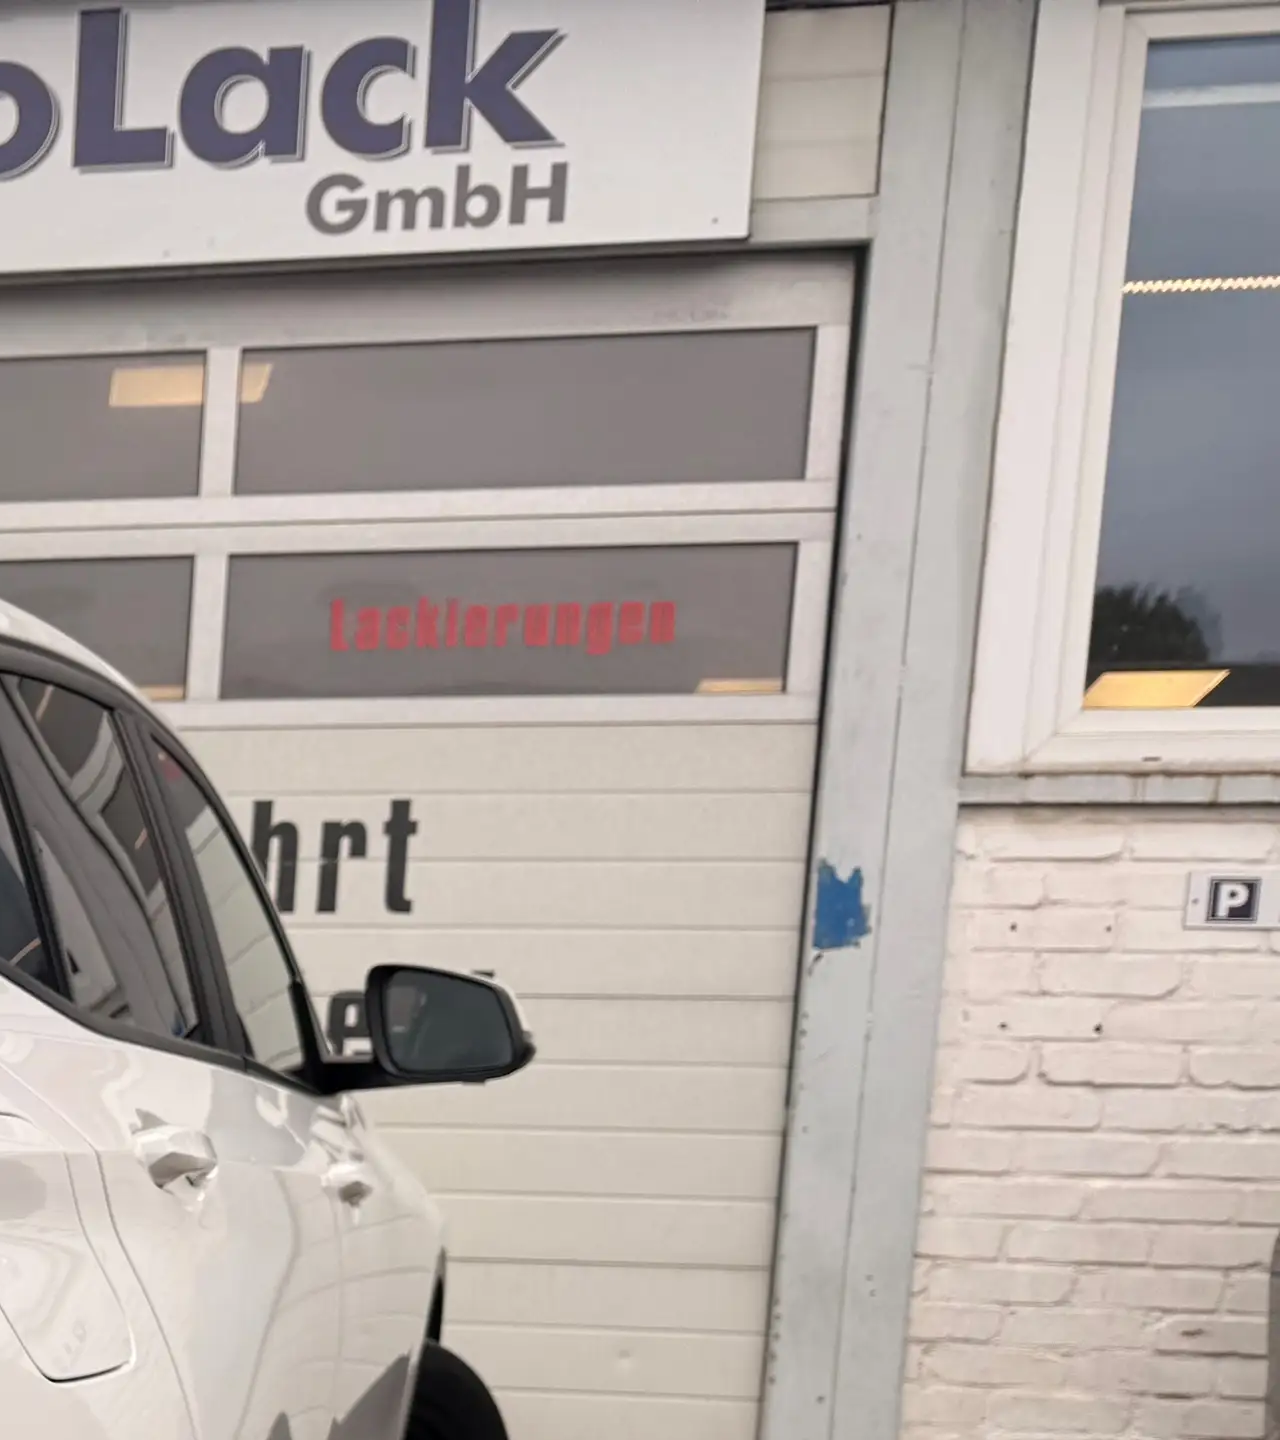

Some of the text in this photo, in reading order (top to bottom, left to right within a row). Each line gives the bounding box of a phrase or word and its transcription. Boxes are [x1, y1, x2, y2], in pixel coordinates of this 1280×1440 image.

[304, 161, 569, 236] GmbH
[330, 596, 676, 656] Lackierungen
[1216, 881, 1250, 918] P
